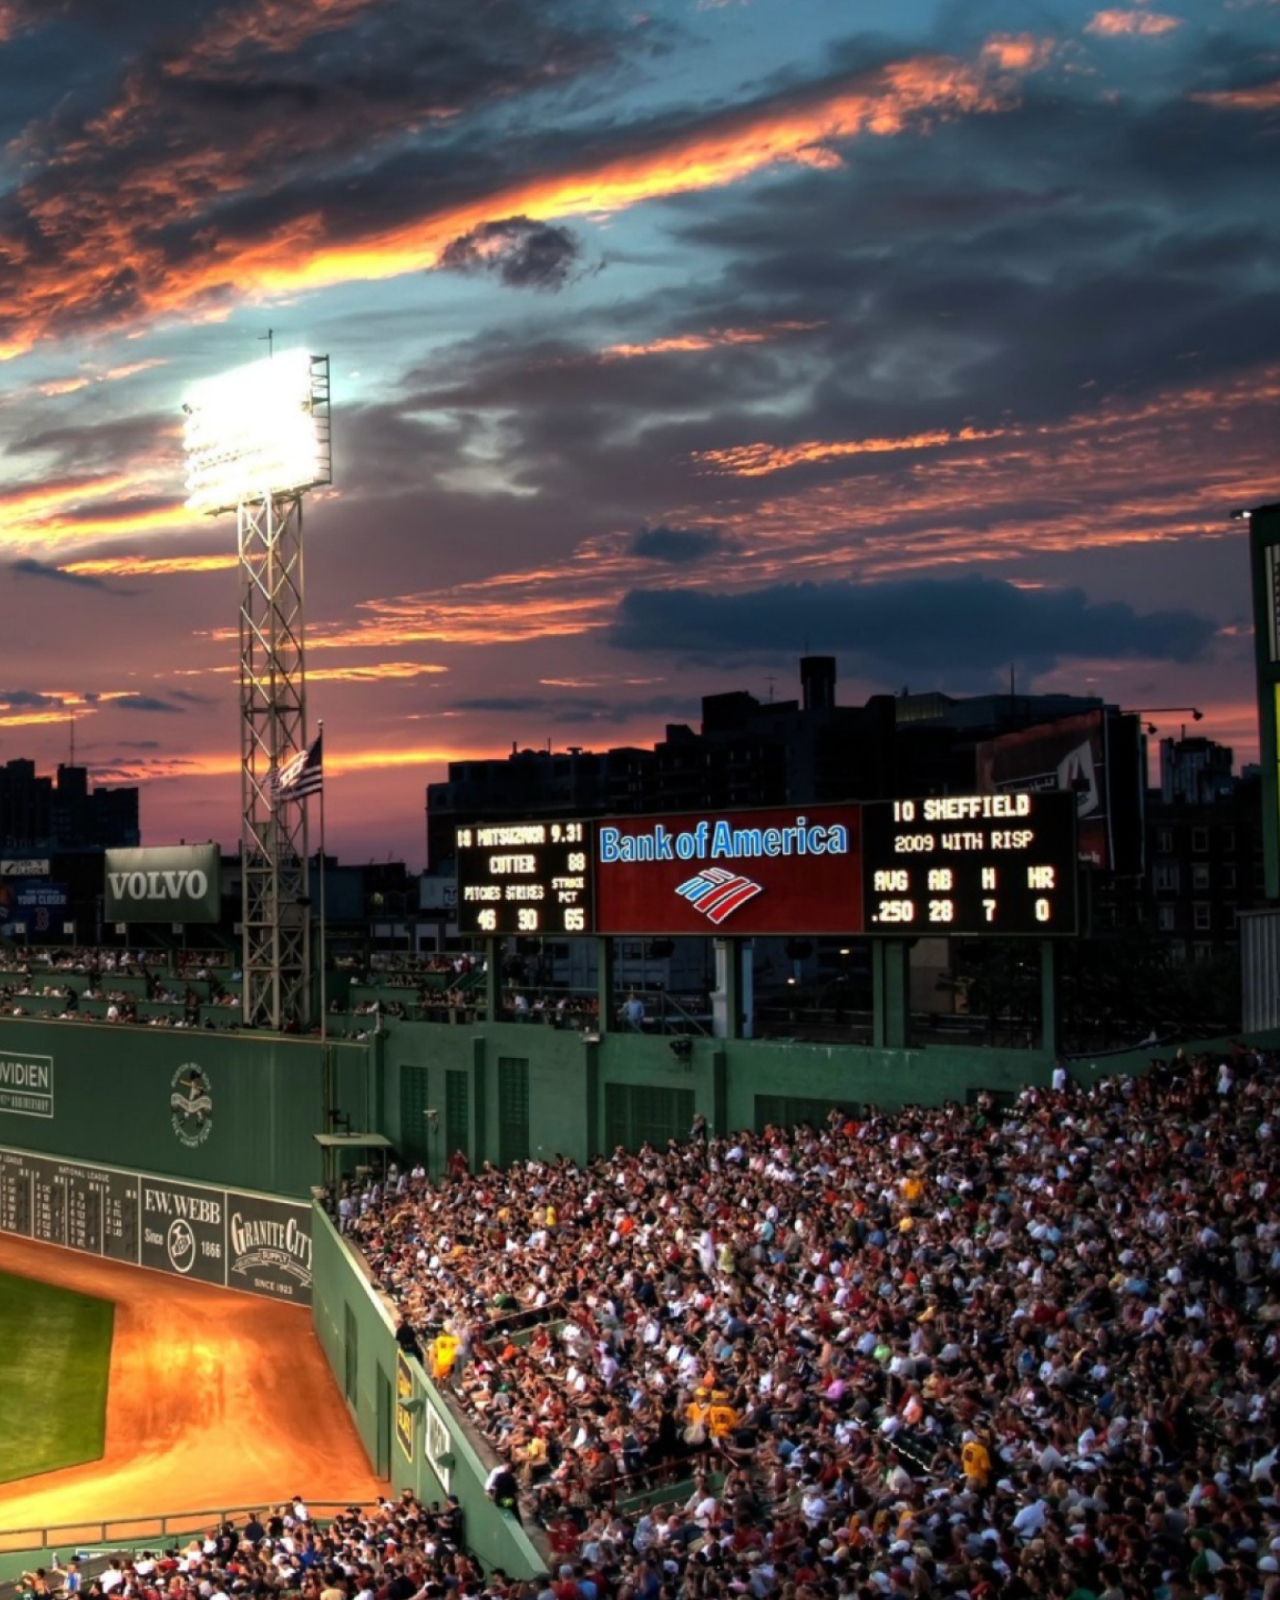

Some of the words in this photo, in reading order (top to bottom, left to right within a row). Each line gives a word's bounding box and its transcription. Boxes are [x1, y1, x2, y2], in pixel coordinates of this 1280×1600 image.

[894, 800, 915, 822] 10
[923, 794, 1030, 821] SHEFFIELD
[550, 823, 583, 843] 9.31
[599, 824, 674, 863] Bank
[674, 821, 709, 860] of
[711, 816, 848, 859] America
[895, 834, 934, 853] 2009
[942, 832, 983, 850] WITH
[991, 829, 1034, 850] RISP
[489, 854, 536, 874] CUTTER
[107, 869, 209, 900] VOLVO
[874, 869, 909, 891] AVG
[927, 868, 953, 891] AB
[981, 866, 996, 890] H
[1027, 865, 1055, 889] HR
[872, 899, 914, 922] .250
[928, 898, 953, 922] 28
[982, 899, 996, 922] 7
[1035, 898, 1050, 921] 0
[58, 1165, 85, 1179] NATIONAL
[87, 1171, 109, 1183] LEAGUE
[173, 1194, 221, 1225] WEBB
[144, 1227, 165, 1246] Since
[201, 1240, 222, 1259] 1866
[261, 1250, 288, 1266] SUPPLY
[253, 1278, 275, 1292] SINCE
